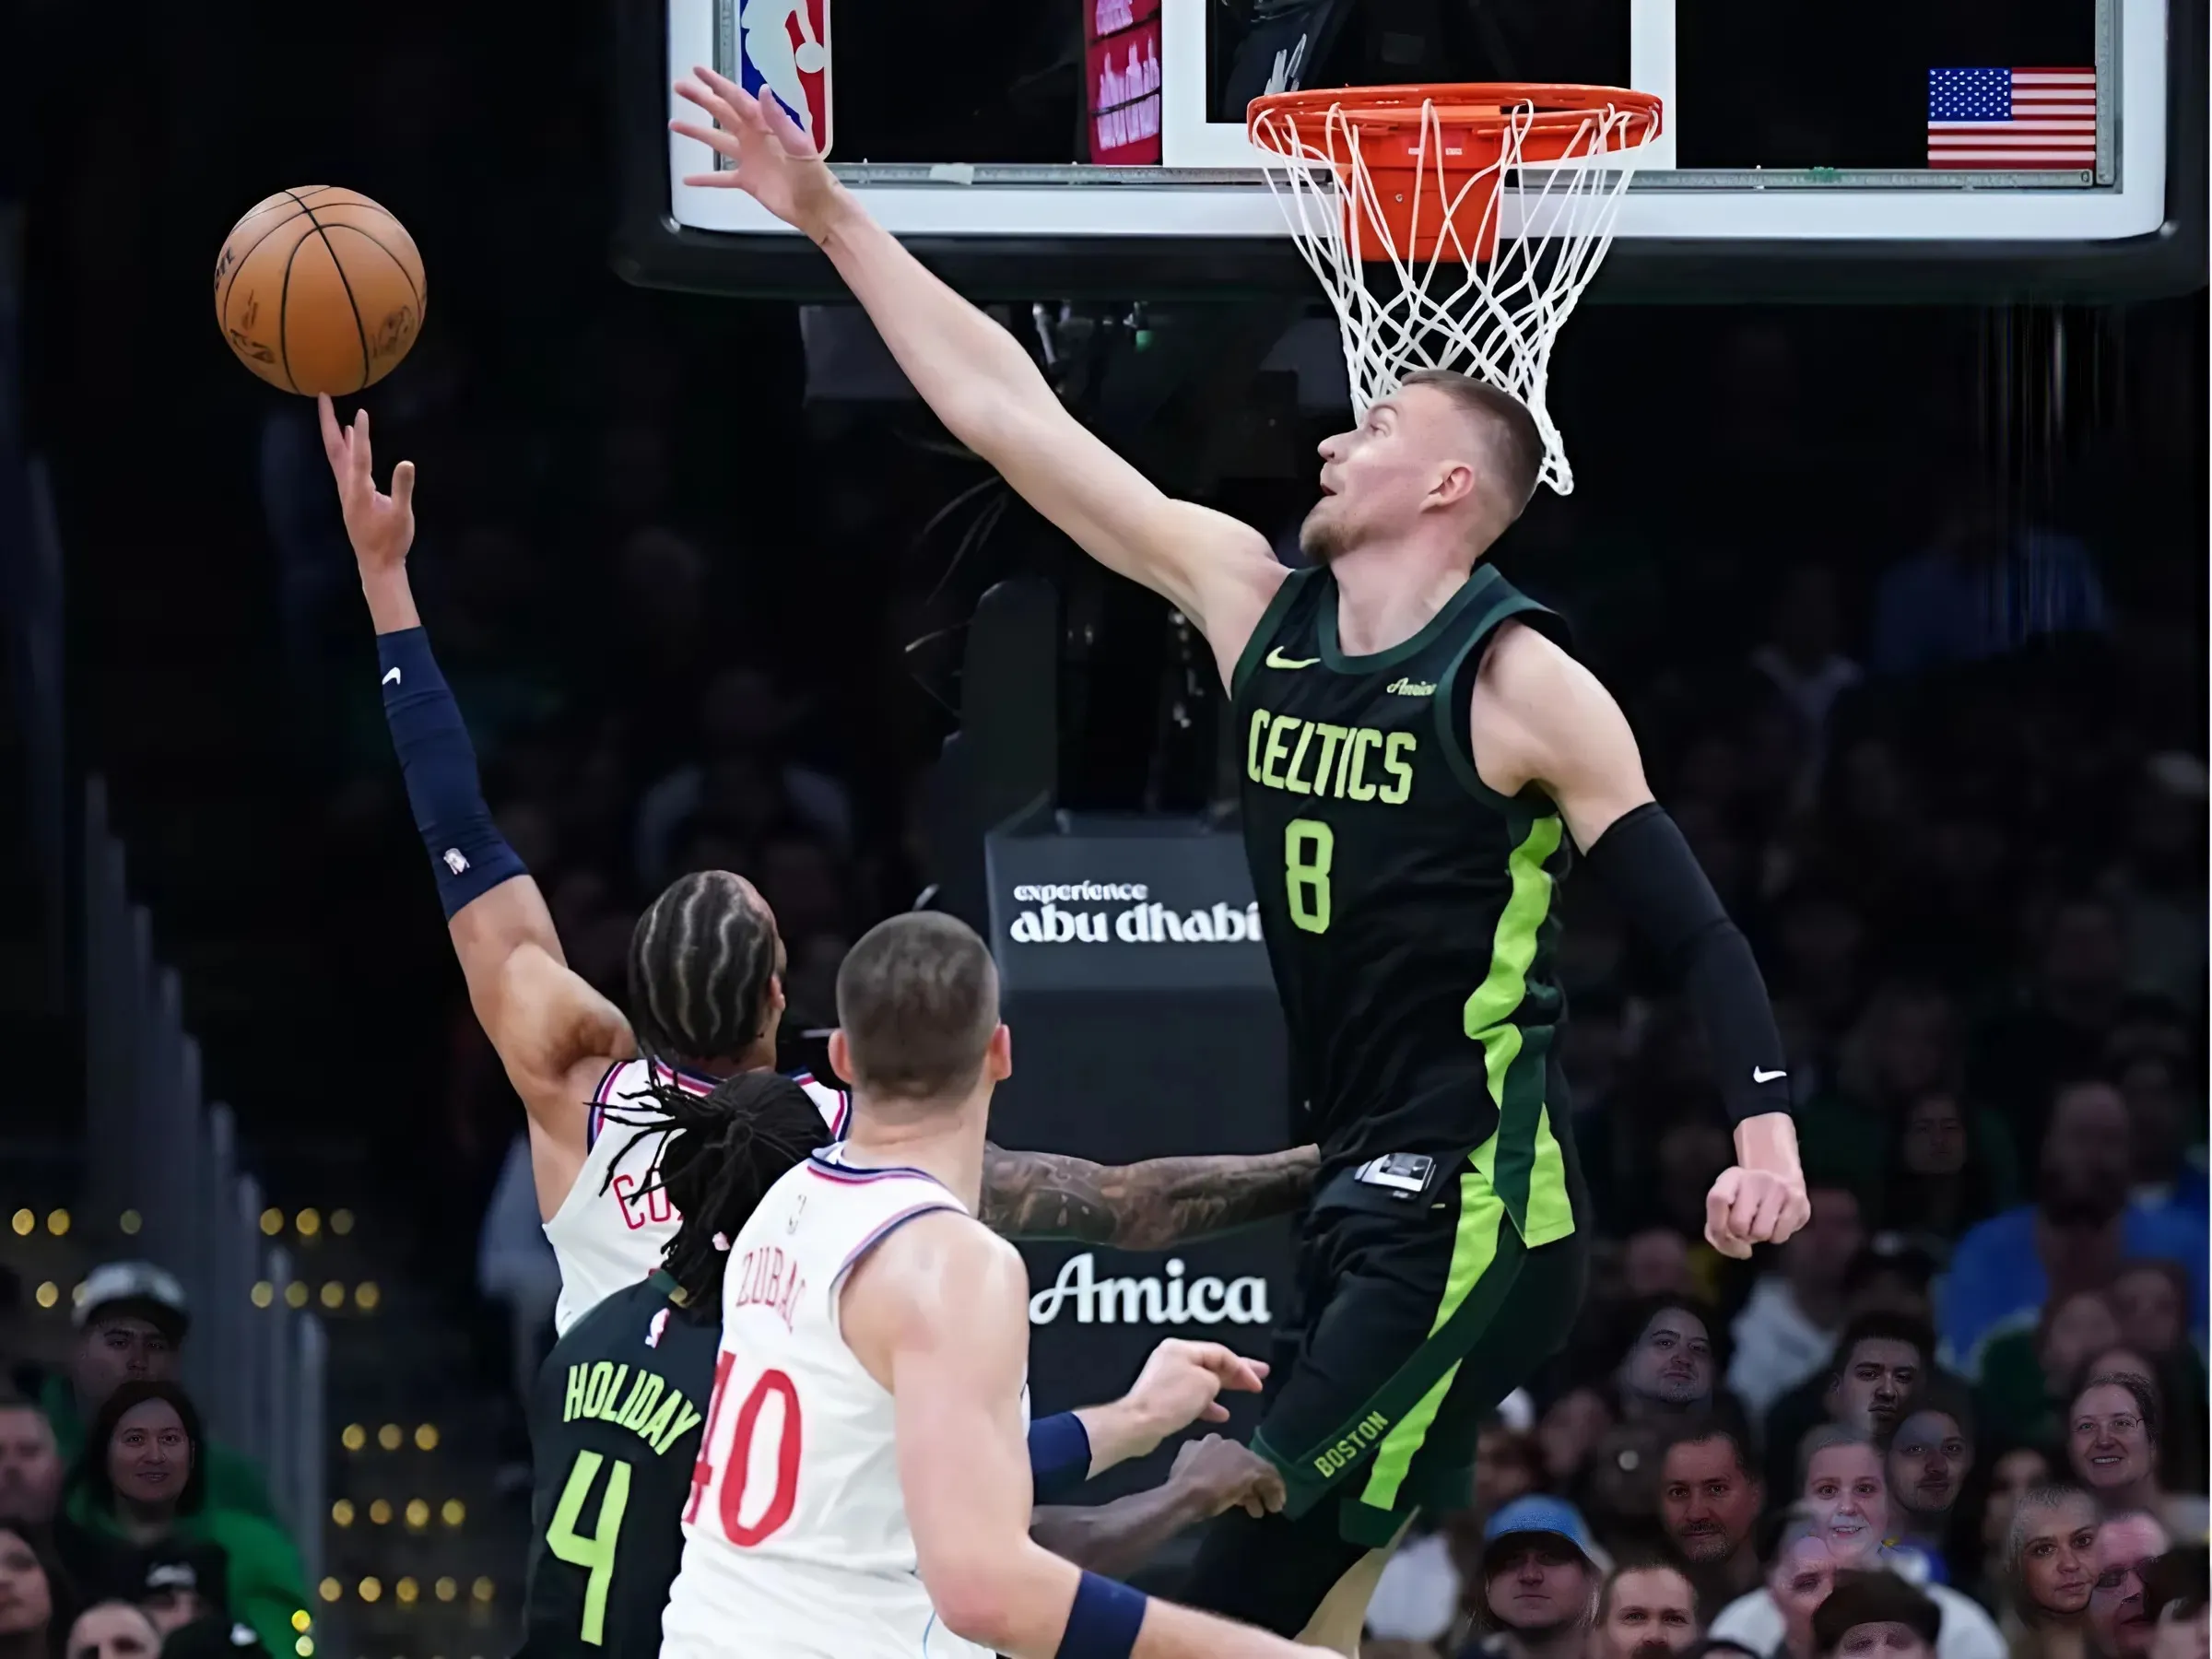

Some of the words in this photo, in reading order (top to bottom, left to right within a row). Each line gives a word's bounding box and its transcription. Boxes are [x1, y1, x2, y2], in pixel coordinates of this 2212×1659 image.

[1247, 708, 1418, 805] CELTICS
[1013, 879, 1148, 904] experience
[1285, 818, 1334, 935] 8
[1009, 902, 1109, 943] abu
[1115, 901, 1263, 943] dhabi
[1029, 1253, 1271, 1324] Amica
[563, 1361, 701, 1455] HOLIDAY
[1313, 1410, 1389, 1478] BOSTON
[546, 1449, 631, 1646] 4
